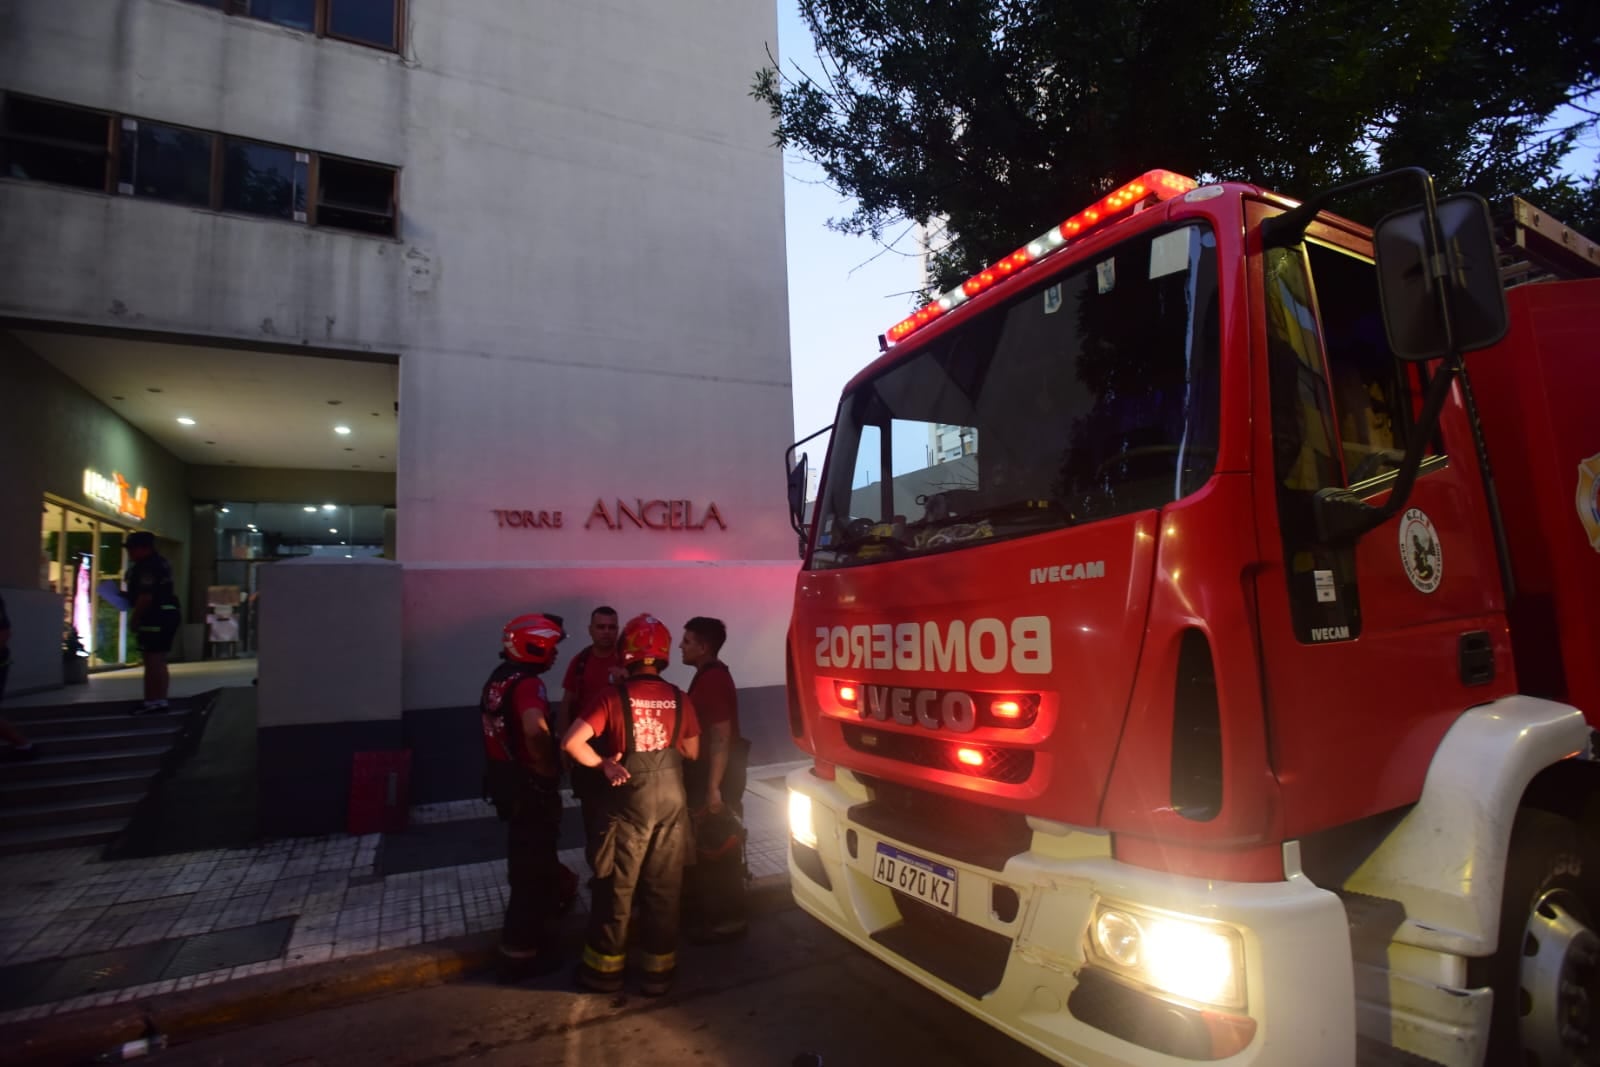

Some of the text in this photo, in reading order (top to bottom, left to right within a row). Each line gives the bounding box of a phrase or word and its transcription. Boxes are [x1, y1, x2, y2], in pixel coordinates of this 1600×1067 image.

[490, 497, 727, 531] TORRE ANGELA
[1030, 560, 1105, 584] IVECAM
[1311, 626, 1350, 641] IVECAM
[857, 684, 976, 733] IVECO
[877, 857, 895, 883] AD
[900, 866, 927, 896] 670
[931, 876, 950, 907] KZ
